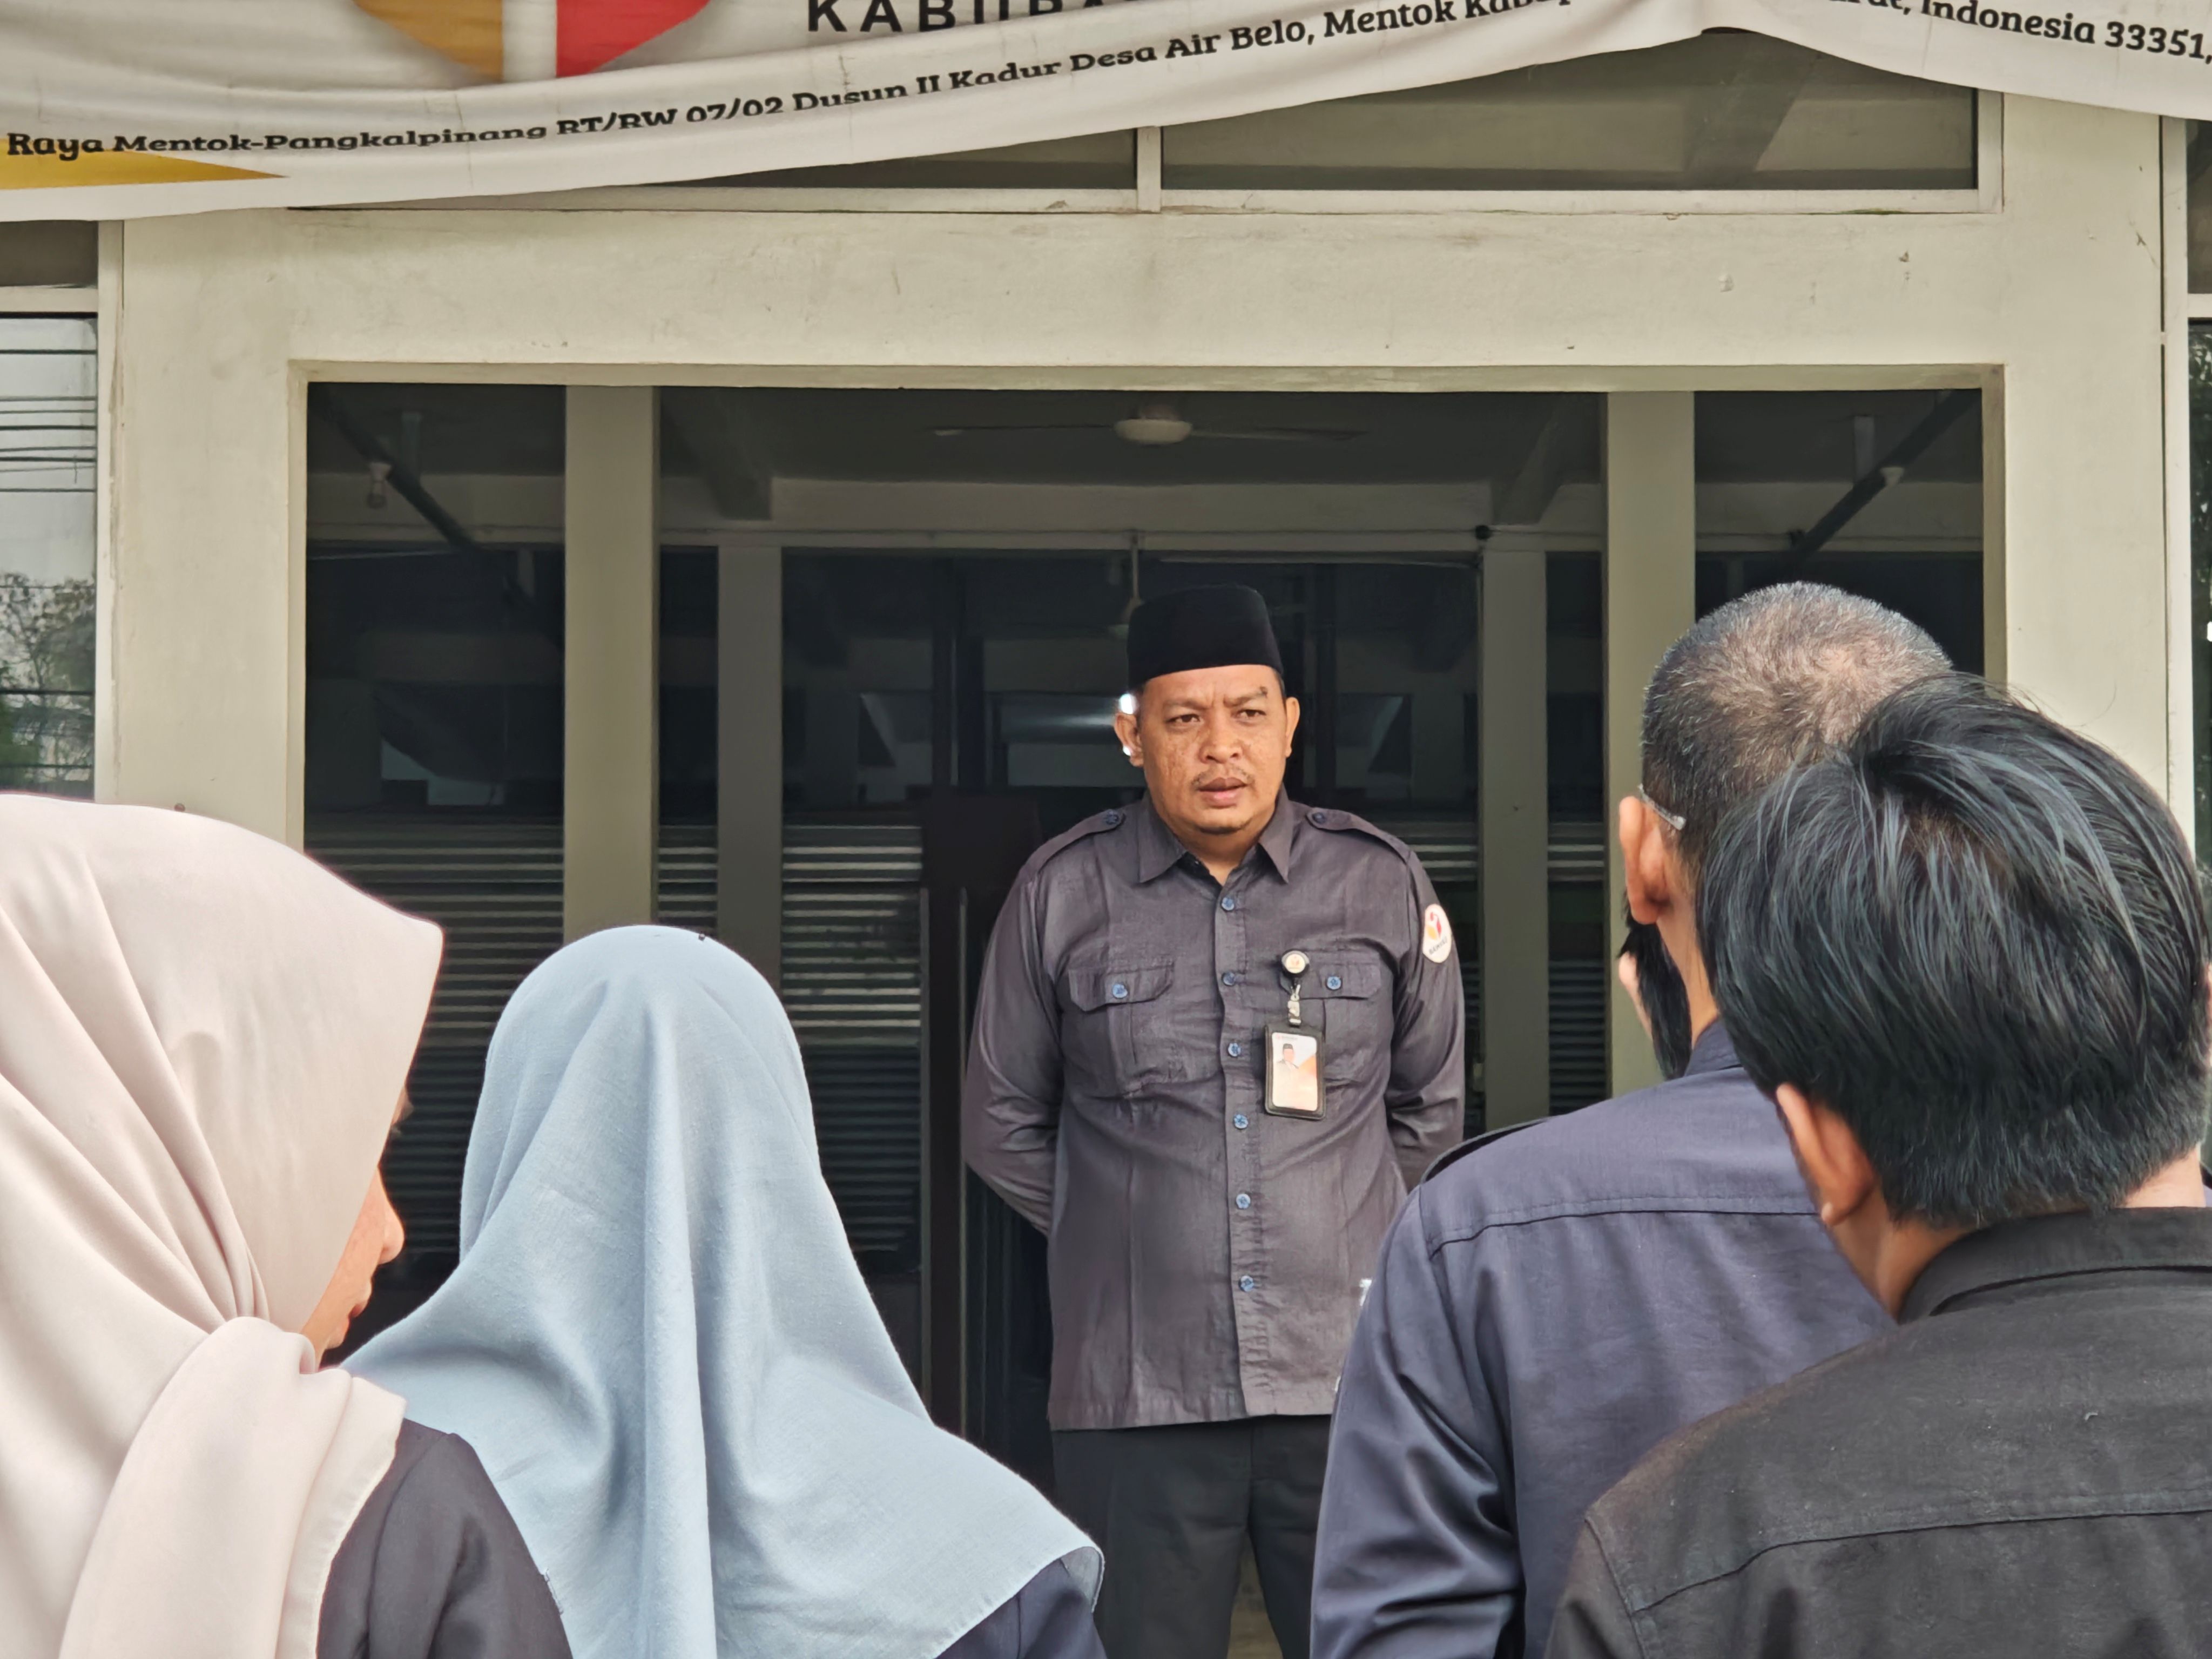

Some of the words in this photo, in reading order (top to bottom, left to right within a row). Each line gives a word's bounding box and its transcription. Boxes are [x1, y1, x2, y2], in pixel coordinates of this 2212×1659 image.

[7, 133, 104, 161] Raya
[112, 127, 547, 152] Mentok-Pangkalpinang
[557, 109, 678, 135] RT/RW
[686, 97, 783, 123] 07/02
[792, 85, 907, 110] Dusun
[916, 75, 940, 93] II
[948, 63, 1061, 89] Kadur
[1070, 48, 1157, 71] Desa
[1165, 34, 1222, 58] Air
[1229, 19, 1315, 50] Belo,
[1324, 0, 1456, 37] Mentok
[1921, 0, 2095, 44] Indonesia
[2105, 21, 2212, 64] 33351,
